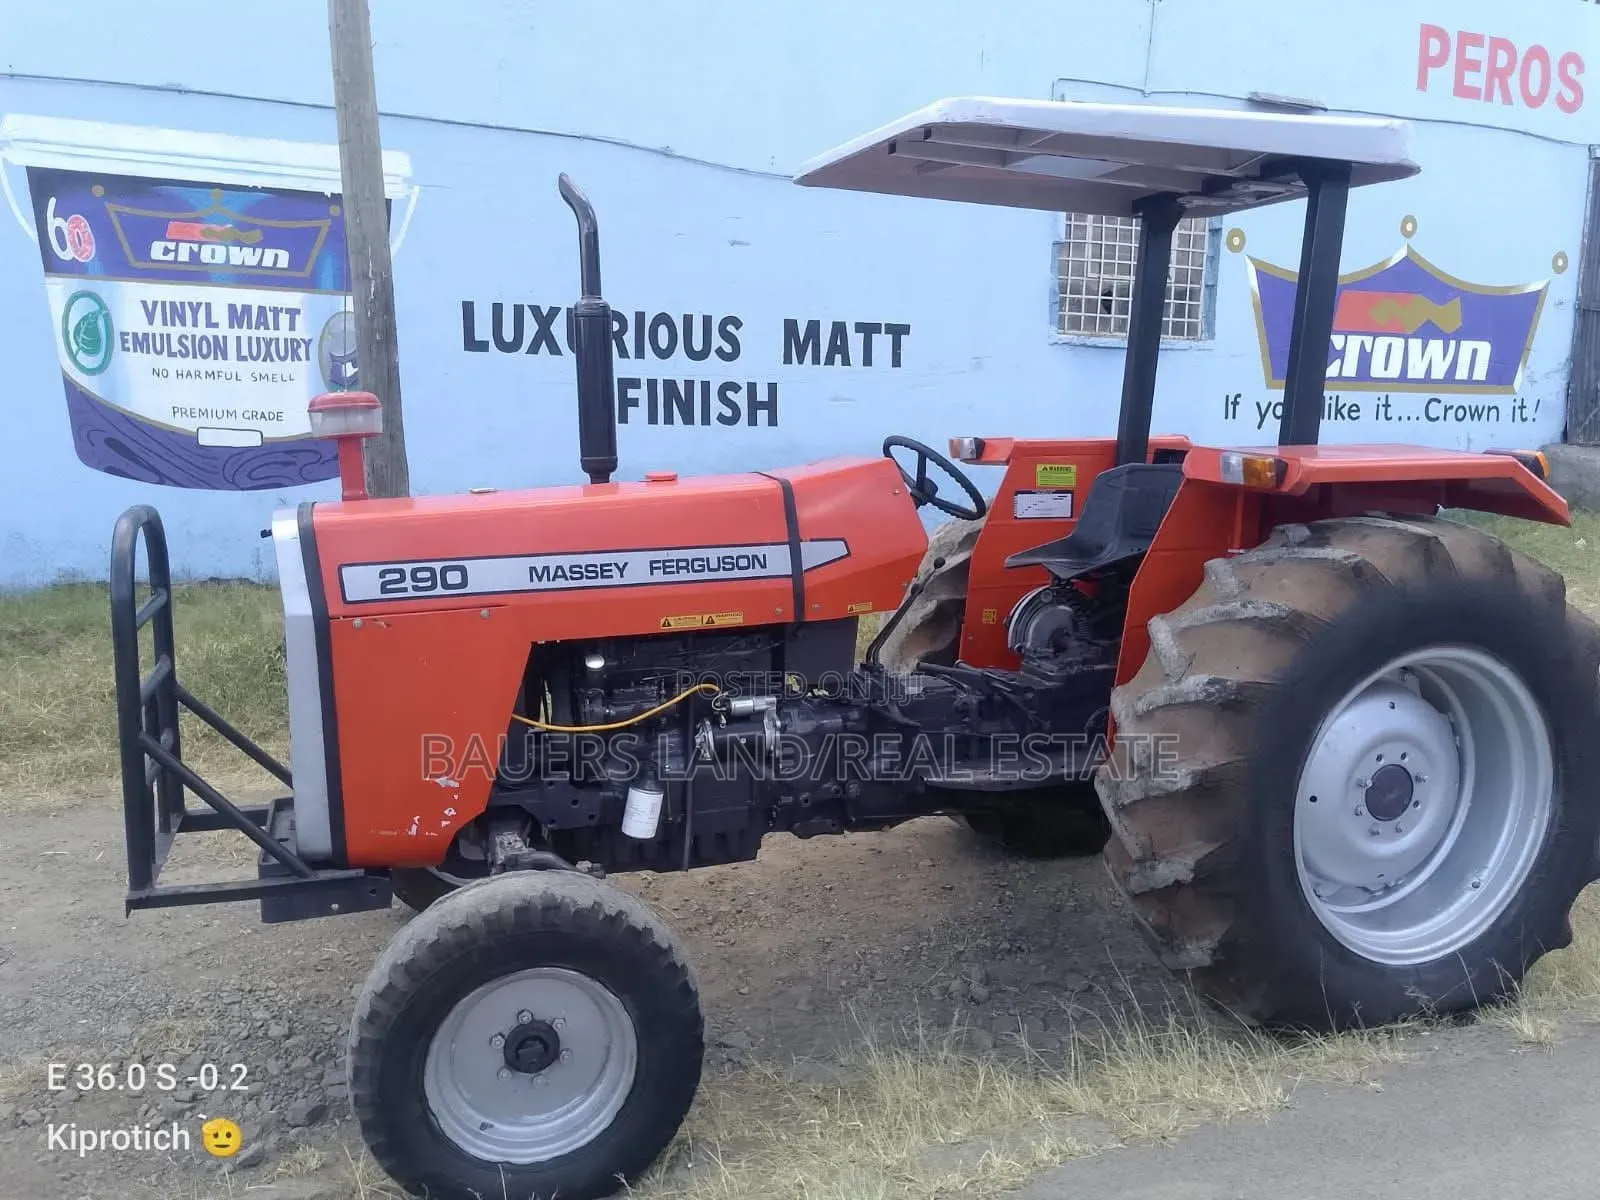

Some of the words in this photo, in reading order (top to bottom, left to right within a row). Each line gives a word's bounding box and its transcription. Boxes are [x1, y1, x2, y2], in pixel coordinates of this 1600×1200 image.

[1416, 23, 1585, 114] PEROS
[47, 197, 96, 262] 60
[150, 240, 290, 269] crown
[140, 300, 219, 329] VINYL
[227, 303, 301, 331] MATT
[119, 331, 228, 361] EMULSION
[235, 335, 313, 362] LUXURY
[783, 318, 911, 368] MATT
[152, 367, 169, 378] NO
[176, 369, 242, 381] HARMFUL
[250, 372, 296, 383] SMELL
[172, 406, 237, 420] PREMIUM
[242, 410, 284, 421] GRADE
[617, 378, 778, 427] FINISH
[1224, 393, 1241, 420] If
[1321, 394, 1361, 421] like
[1511, 398, 1541, 423] it!
[379, 564, 469, 595] 290
[528, 561, 629, 584] MASSEY
[648, 553, 768, 577] FERGUSON
